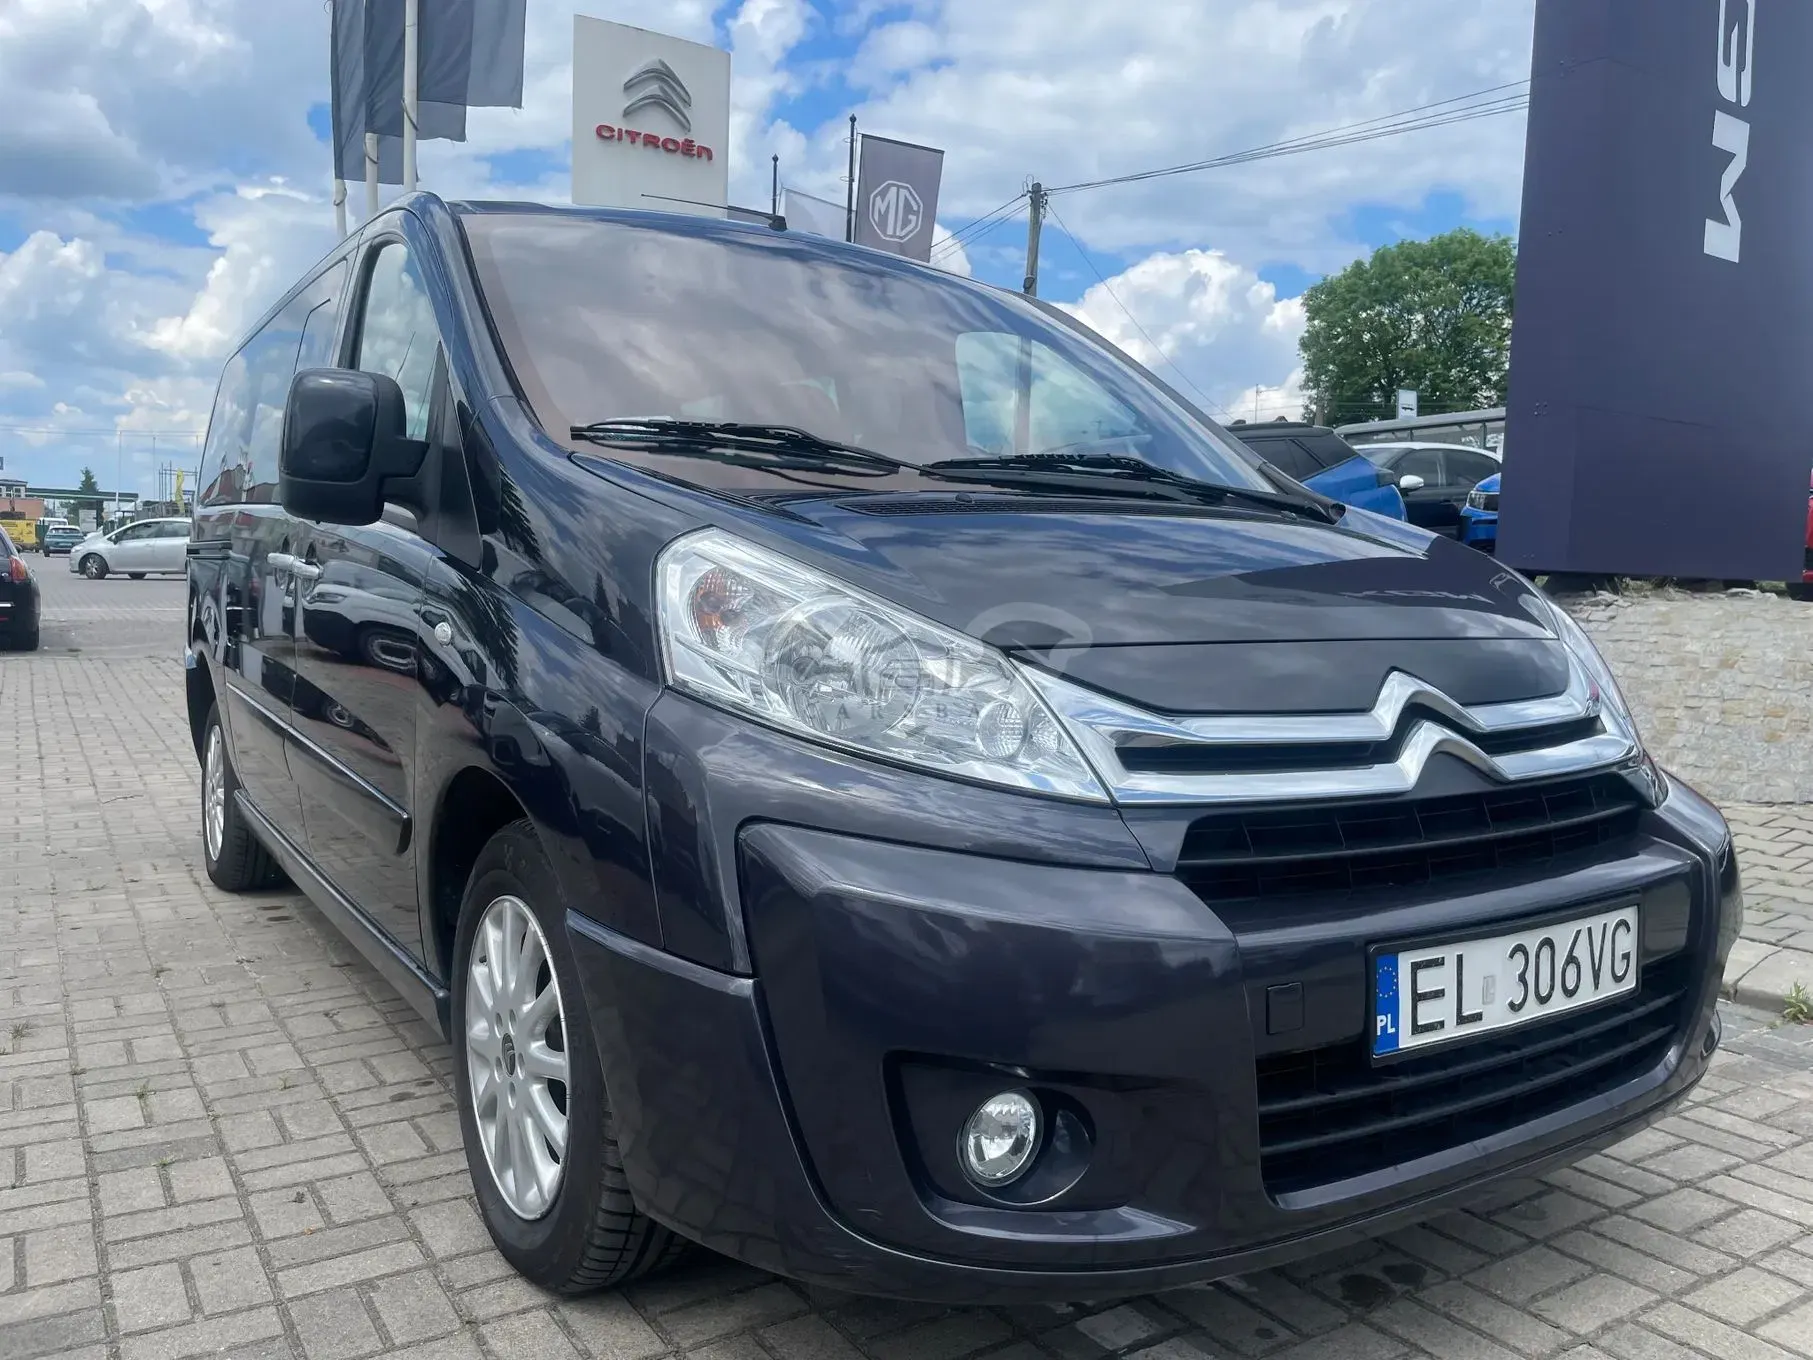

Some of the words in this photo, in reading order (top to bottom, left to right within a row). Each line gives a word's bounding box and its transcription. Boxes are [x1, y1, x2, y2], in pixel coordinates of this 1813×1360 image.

[873, 185, 919, 237] MG
[1410, 952, 1483, 1036] EL
[1506, 918, 1632, 1013] 306VG
[1376, 1013, 1396, 1036] PL
